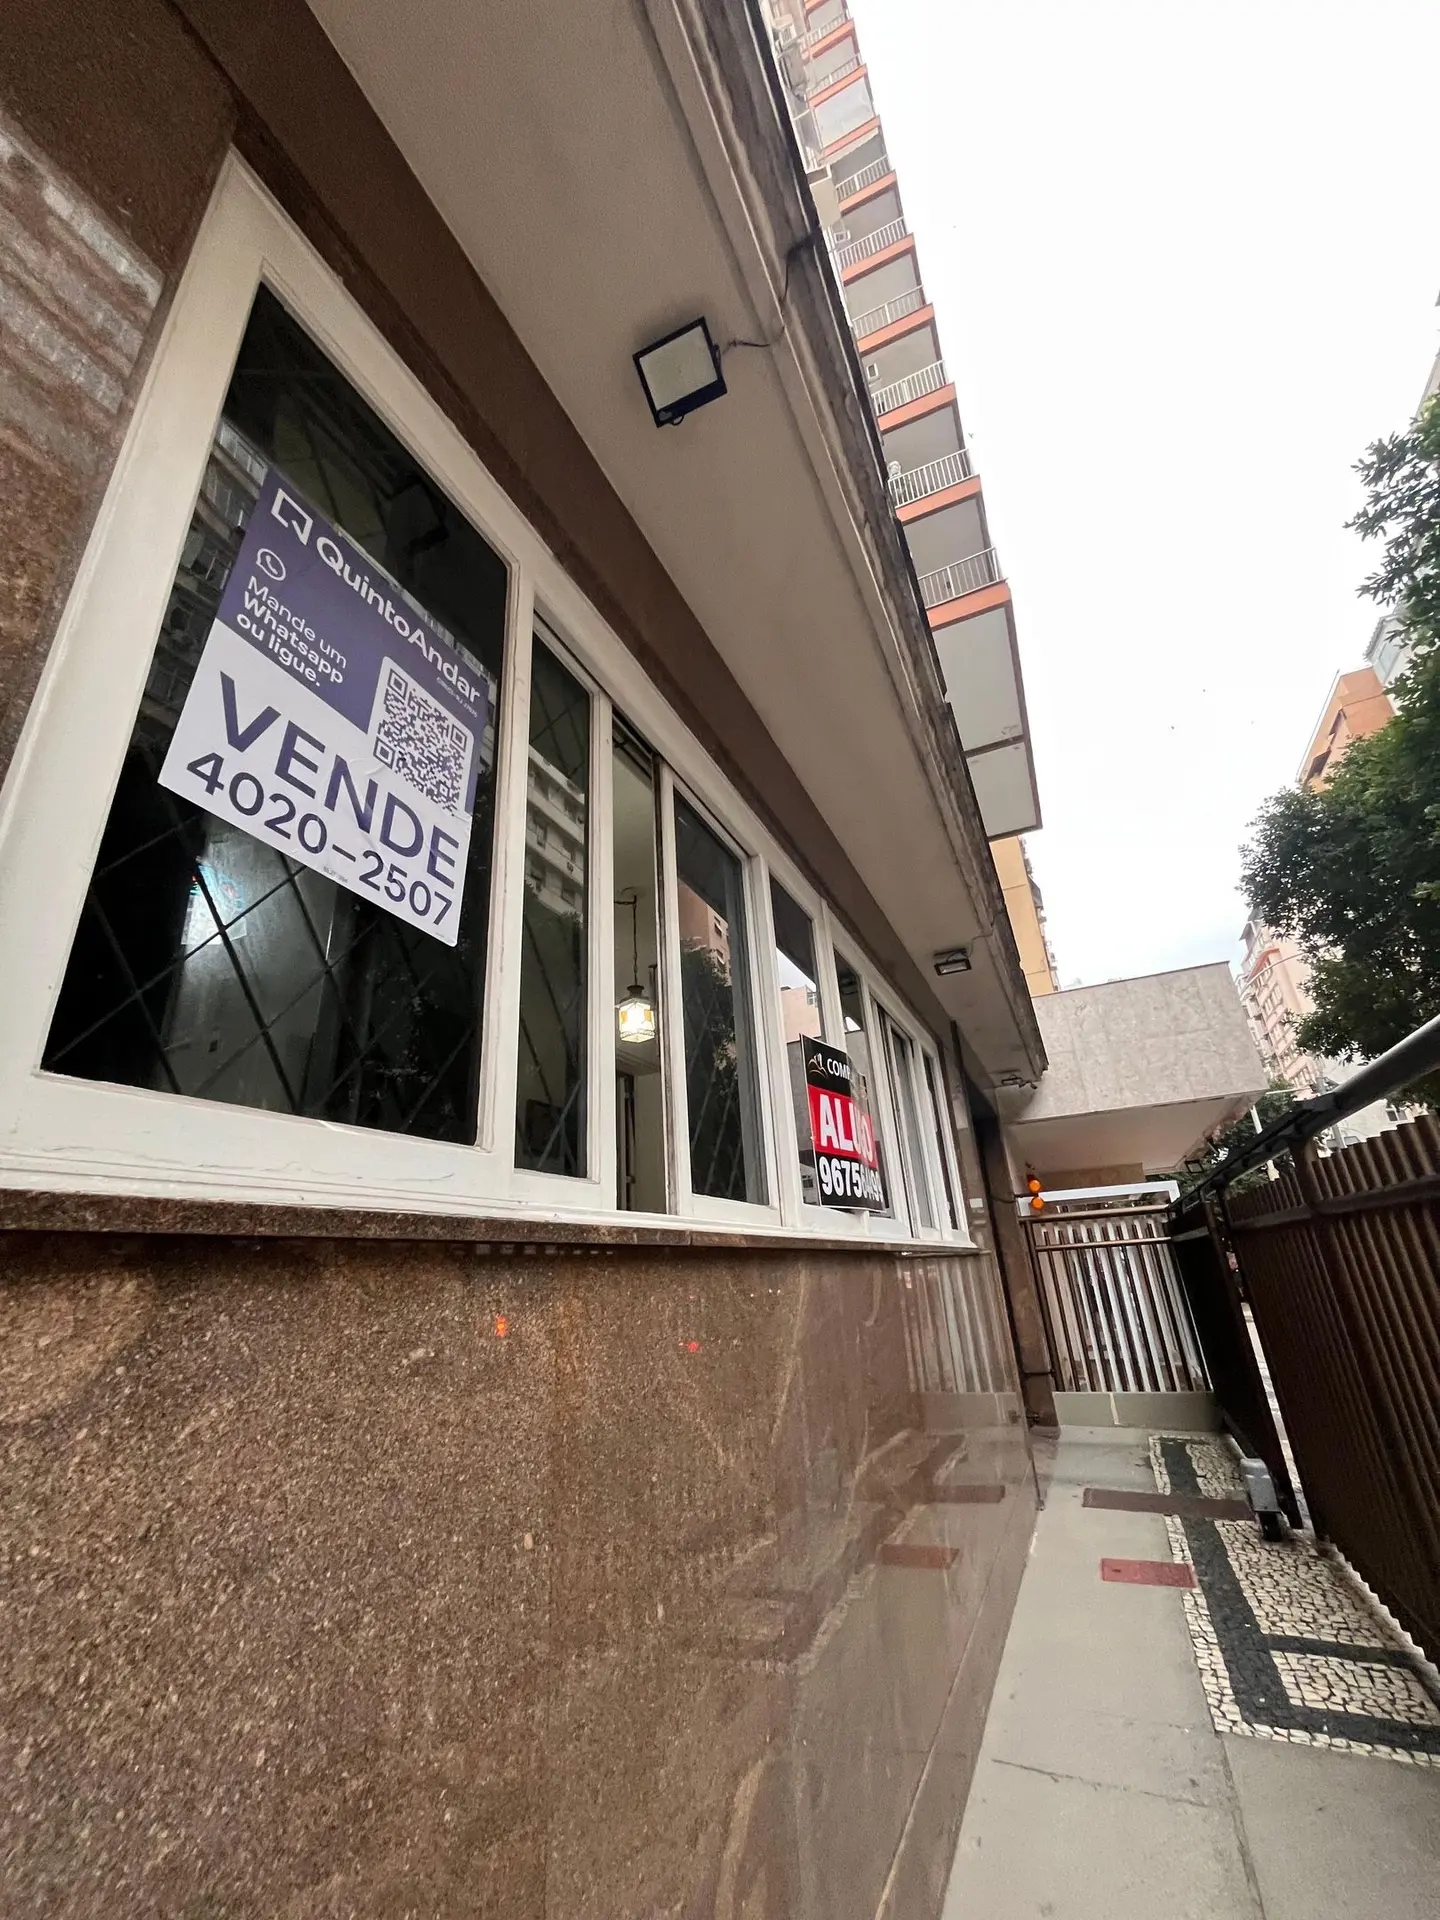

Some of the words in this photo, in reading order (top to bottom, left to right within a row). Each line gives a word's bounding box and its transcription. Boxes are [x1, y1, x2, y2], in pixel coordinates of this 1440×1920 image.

[236, 613, 265, 641] ou
[268, 634, 320, 687] ligue.
[244, 590, 343, 684] Whatsapp
[248, 576, 316, 641] Mande
[320, 639, 347, 669] um
[316, 537, 480, 703] QuintoAndar
[186, 752, 453, 926] 4020-2507
[219, 671, 460, 889] VENDE
